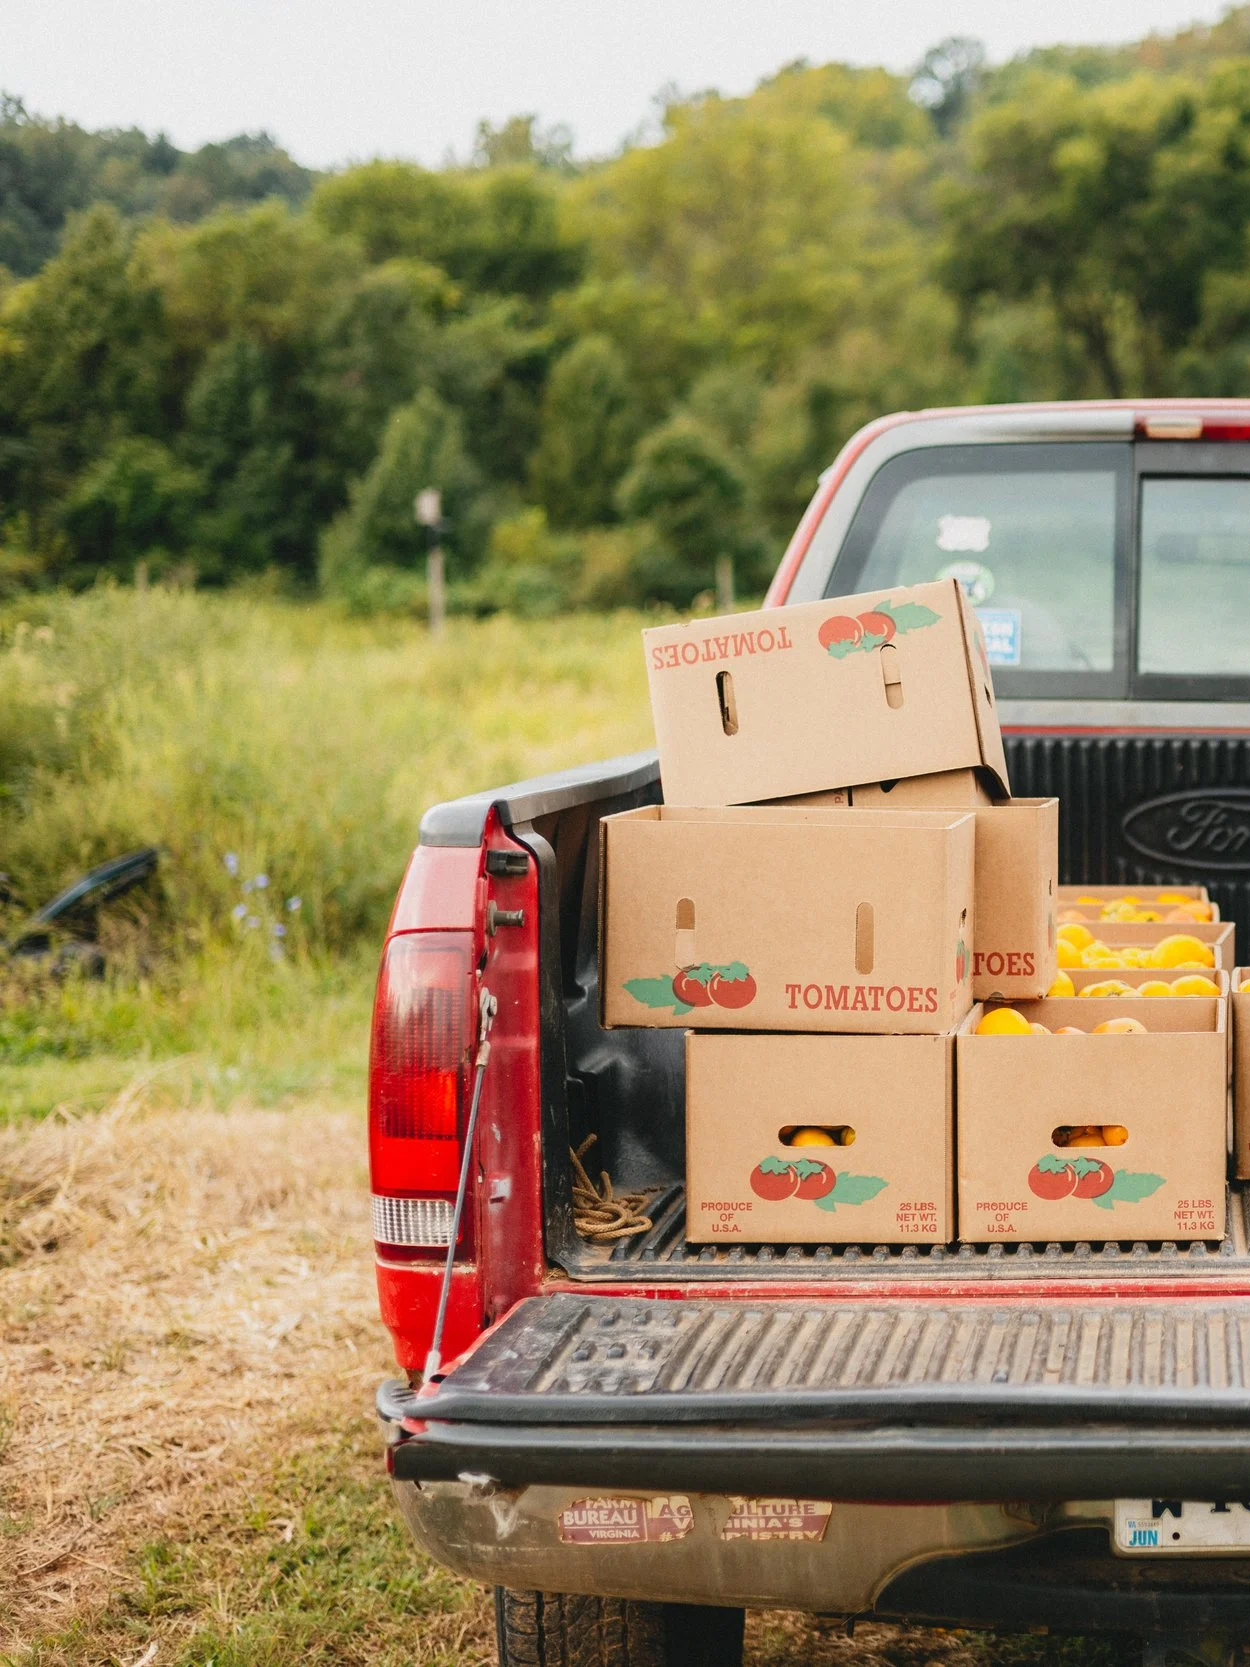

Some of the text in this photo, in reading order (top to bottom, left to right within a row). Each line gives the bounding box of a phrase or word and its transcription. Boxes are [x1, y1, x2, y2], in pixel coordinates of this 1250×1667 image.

[652, 626, 793, 670] TOMATOES
[785, 983, 939, 1013] TOMATOES
[701, 1202, 753, 1211] PRODUCE
[899, 1202, 937, 1211] 25 LBS.
[976, 1202, 1028, 1211] PRODUCE
[1177, 1200, 1215, 1209] 25 LBS.
[719, 1213, 734, 1222] OF
[896, 1213, 937, 1222] NET WT.
[995, 1213, 1009, 1222] OF
[1173, 1211, 1215, 1220] NET WT.
[711, 1224, 742, 1233] U.S.A.
[899, 1224, 937, 1233] 11.3 KG
[987, 1224, 1017, 1233] U.S.A.
[1177, 1221, 1215, 1231] 11.3 KG
[563, 1509, 637, 1526] BUREAU
[588, 1529, 640, 1539] VIRGINIA
[1128, 1529, 1159, 1546] JUN
